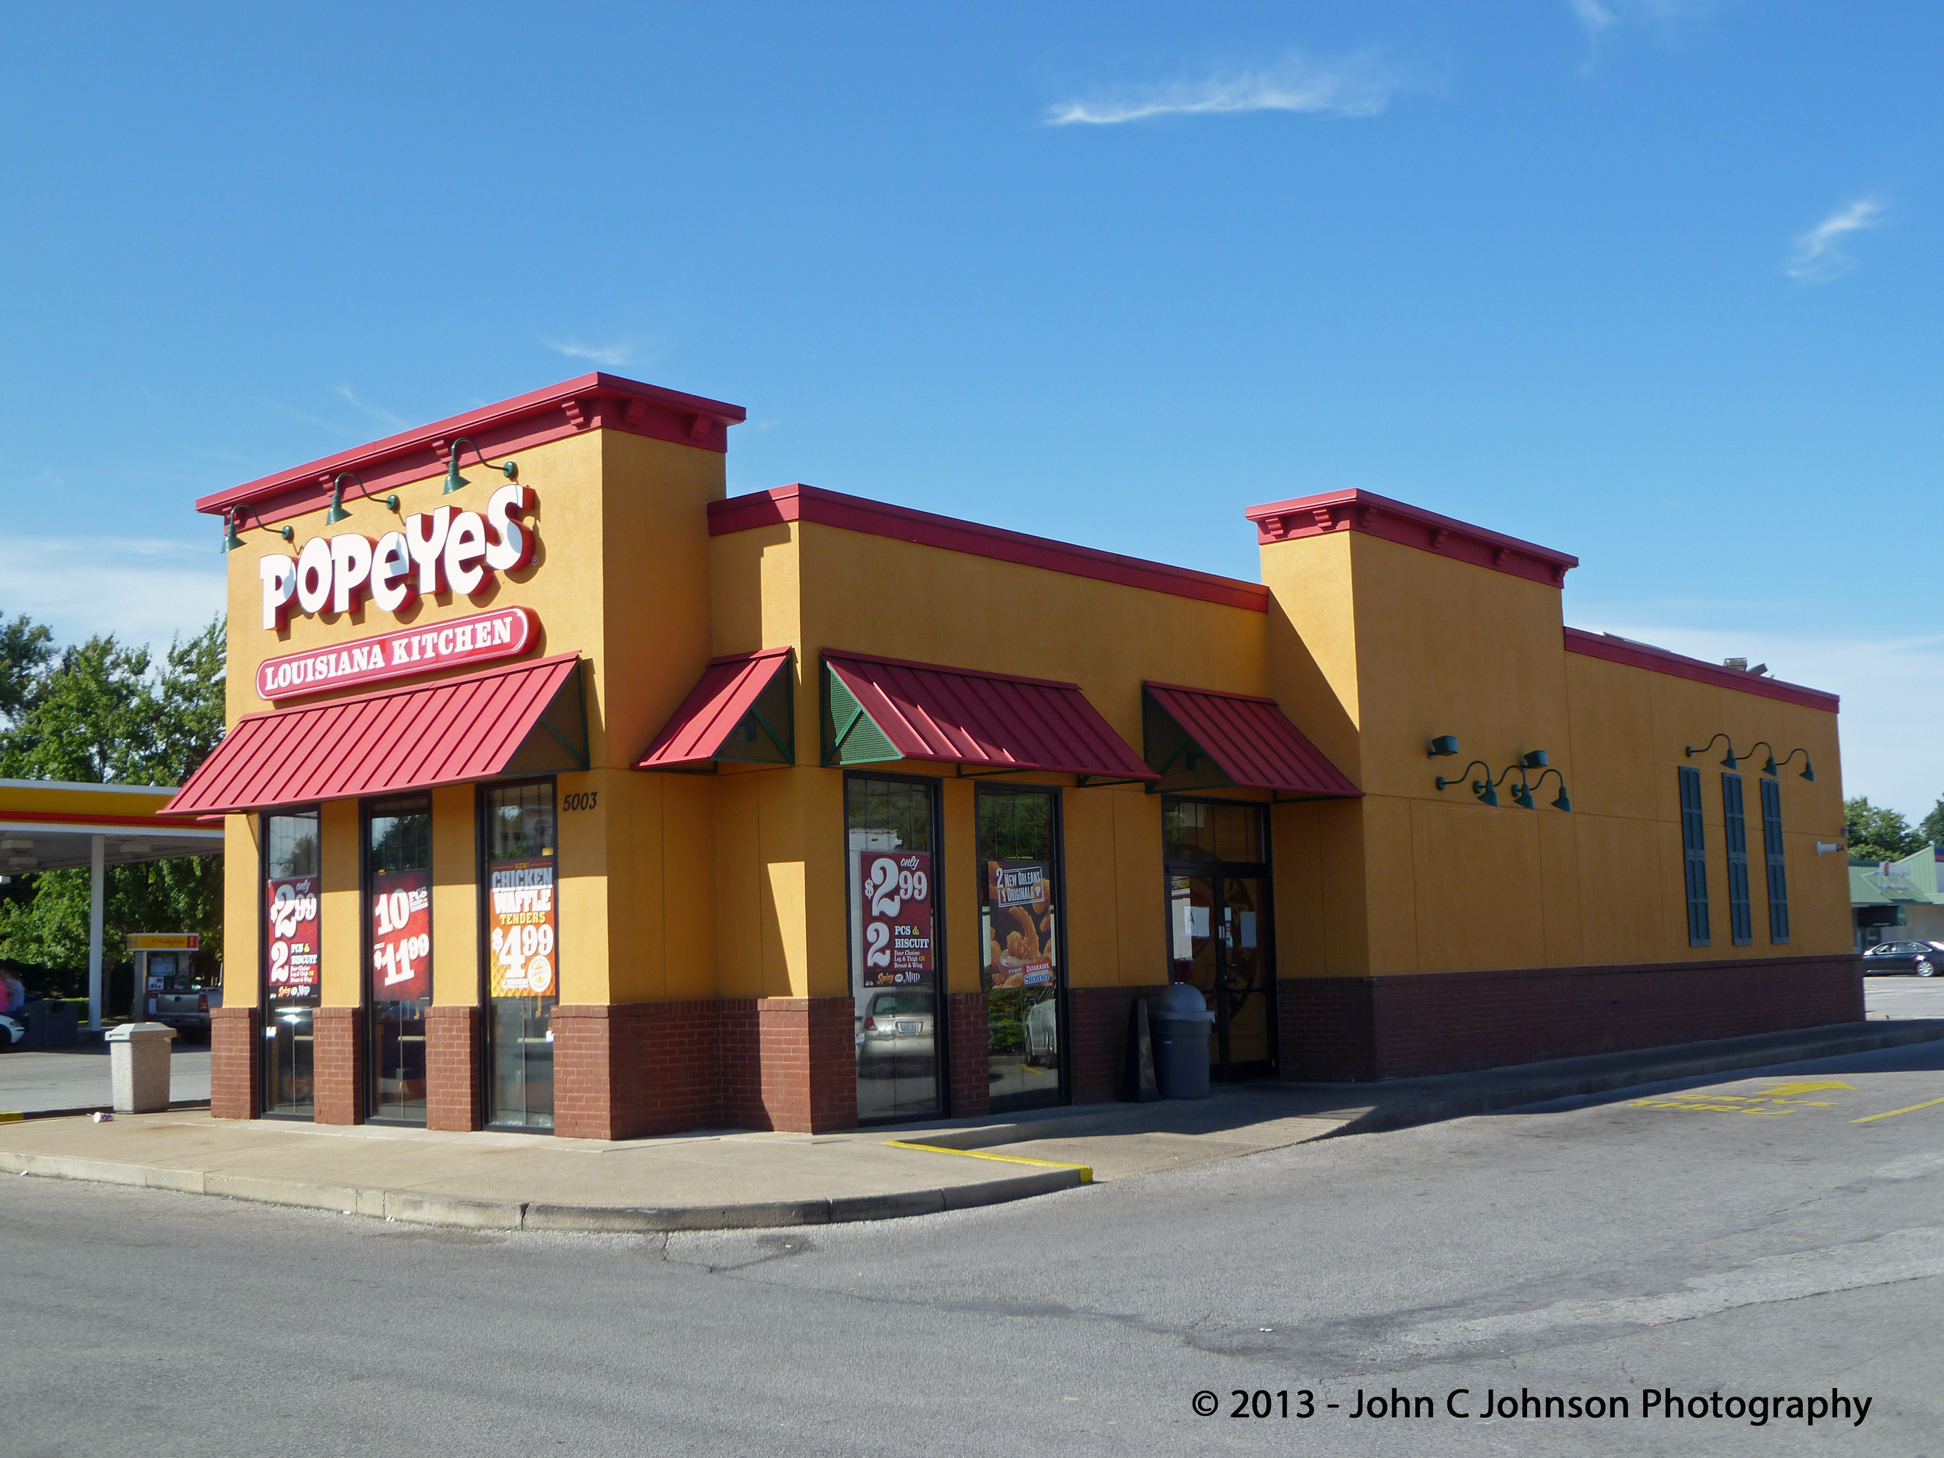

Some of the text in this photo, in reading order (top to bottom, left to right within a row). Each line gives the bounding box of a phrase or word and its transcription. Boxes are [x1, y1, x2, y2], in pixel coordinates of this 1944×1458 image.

[264, 617, 513, 691] LOUISIANA KITCHEN
[563, 792, 598, 811] 5003
[900, 855, 920, 870] only
[492, 867, 553, 893] CHICKEN
[996, 868, 1041, 888] 2 NEW ORLEANS
[296, 879, 311, 893] only
[1007, 886, 1035, 902] ORIGINALS
[494, 889, 551, 915] WAFFLE
[375, 888, 410, 936] 10
[408, 886, 428, 902] PCS
[500, 912, 546, 925] TENDERS
[894, 925, 920, 936] PCS &
[867, 922, 890, 967] 2
[894, 938, 929, 949] BISCUIT
[271, 941, 289, 983] 2
[877, 973, 895, 986] Spicy
[1025, 974, 1051, 984] SHRIMP
[1630, 1100, 1796, 1115] THRU
[1673, 1094, 1840, 1107] DRIVE
